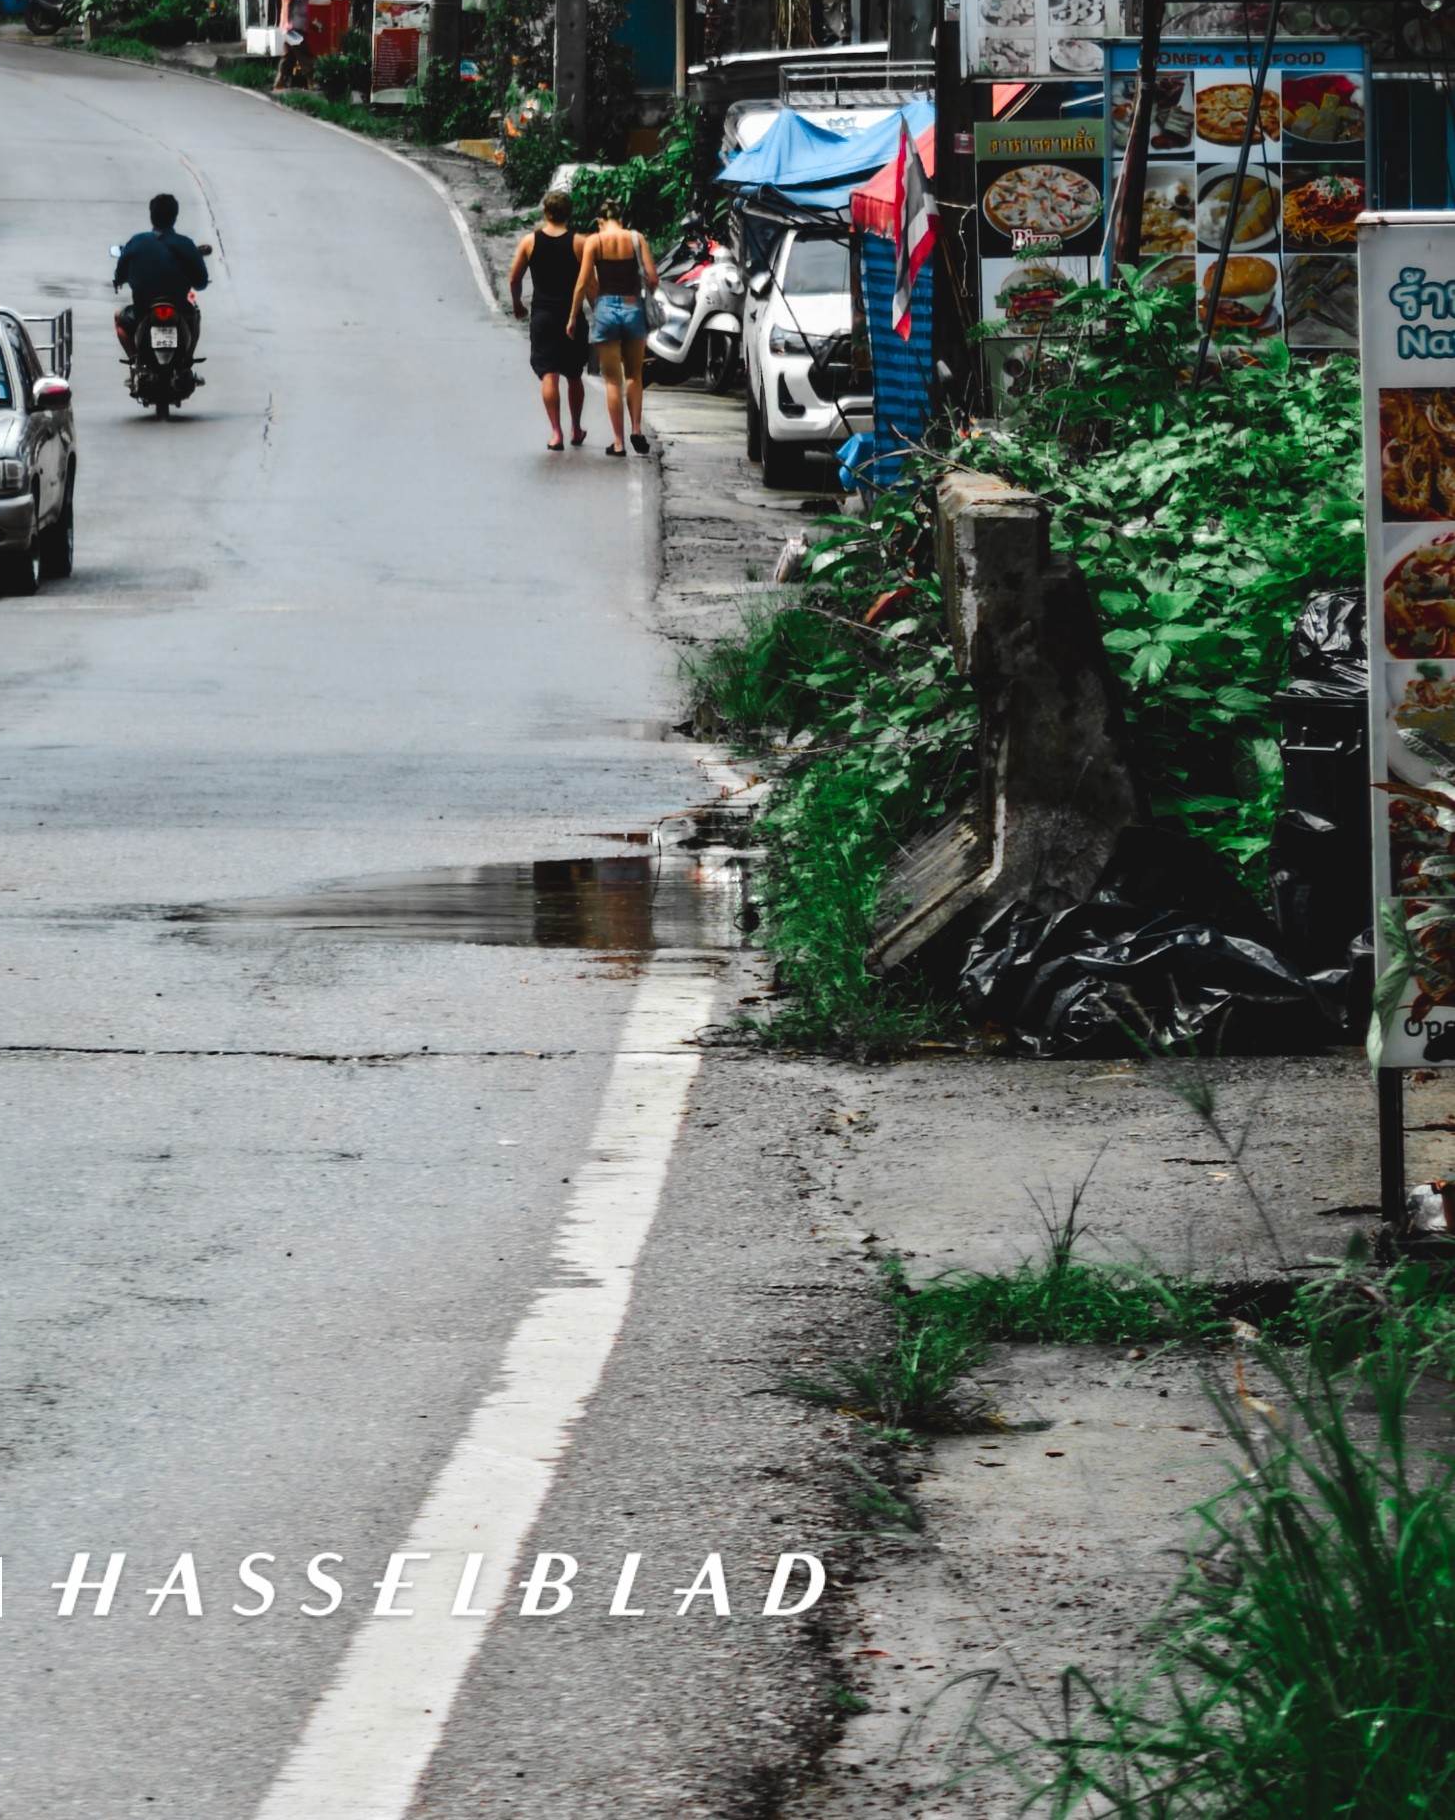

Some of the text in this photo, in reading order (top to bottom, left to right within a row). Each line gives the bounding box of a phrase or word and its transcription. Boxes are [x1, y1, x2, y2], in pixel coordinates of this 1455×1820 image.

[1155, 51, 1327, 66] ONEKA SEFOOD
[990, 126, 1096, 154] อาหารตามสั่ง
[1397, 323, 1455, 360] Na
